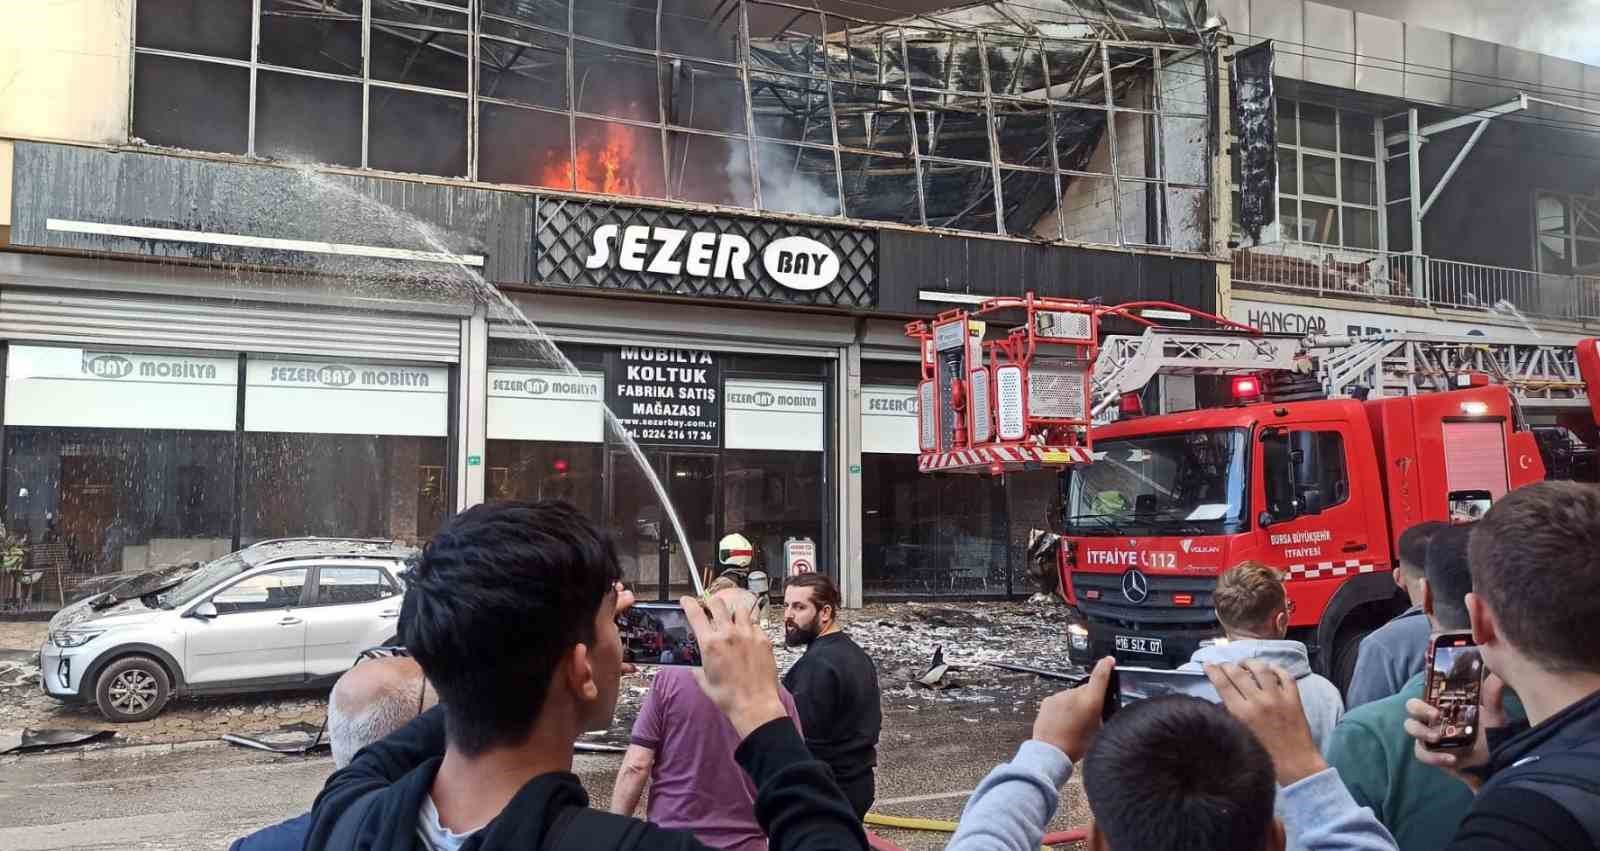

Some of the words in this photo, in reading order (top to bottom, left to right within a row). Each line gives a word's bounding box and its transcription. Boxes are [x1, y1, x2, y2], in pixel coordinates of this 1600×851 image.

[585, 223, 751, 280] SEZER
[776, 250, 829, 276] BAY
[94, 360, 129, 376] BAY
[140, 360, 216, 379] MOBİLYA
[271, 366, 317, 382] SEZER
[321, 369, 351, 384] BAY
[361, 369, 429, 387] MOBİLYA
[627, 365, 707, 383] KOLTUK
[494, 379, 523, 392] SEZER
[678, 387, 716, 403] SATIŞ
[632, 401, 701, 417] MAĞAZASI
[870, 398, 903, 411] SEZER
[616, 418, 717, 428] www.sezerbay.com.tr
[642, 429, 666, 439] 0224
[668, 430, 685, 440] 216
[687, 431, 698, 440] 17
[700, 431, 712, 441] 36
[1087, 547, 1137, 565] İTFAİYE
[1150, 552, 1176, 568] 112
